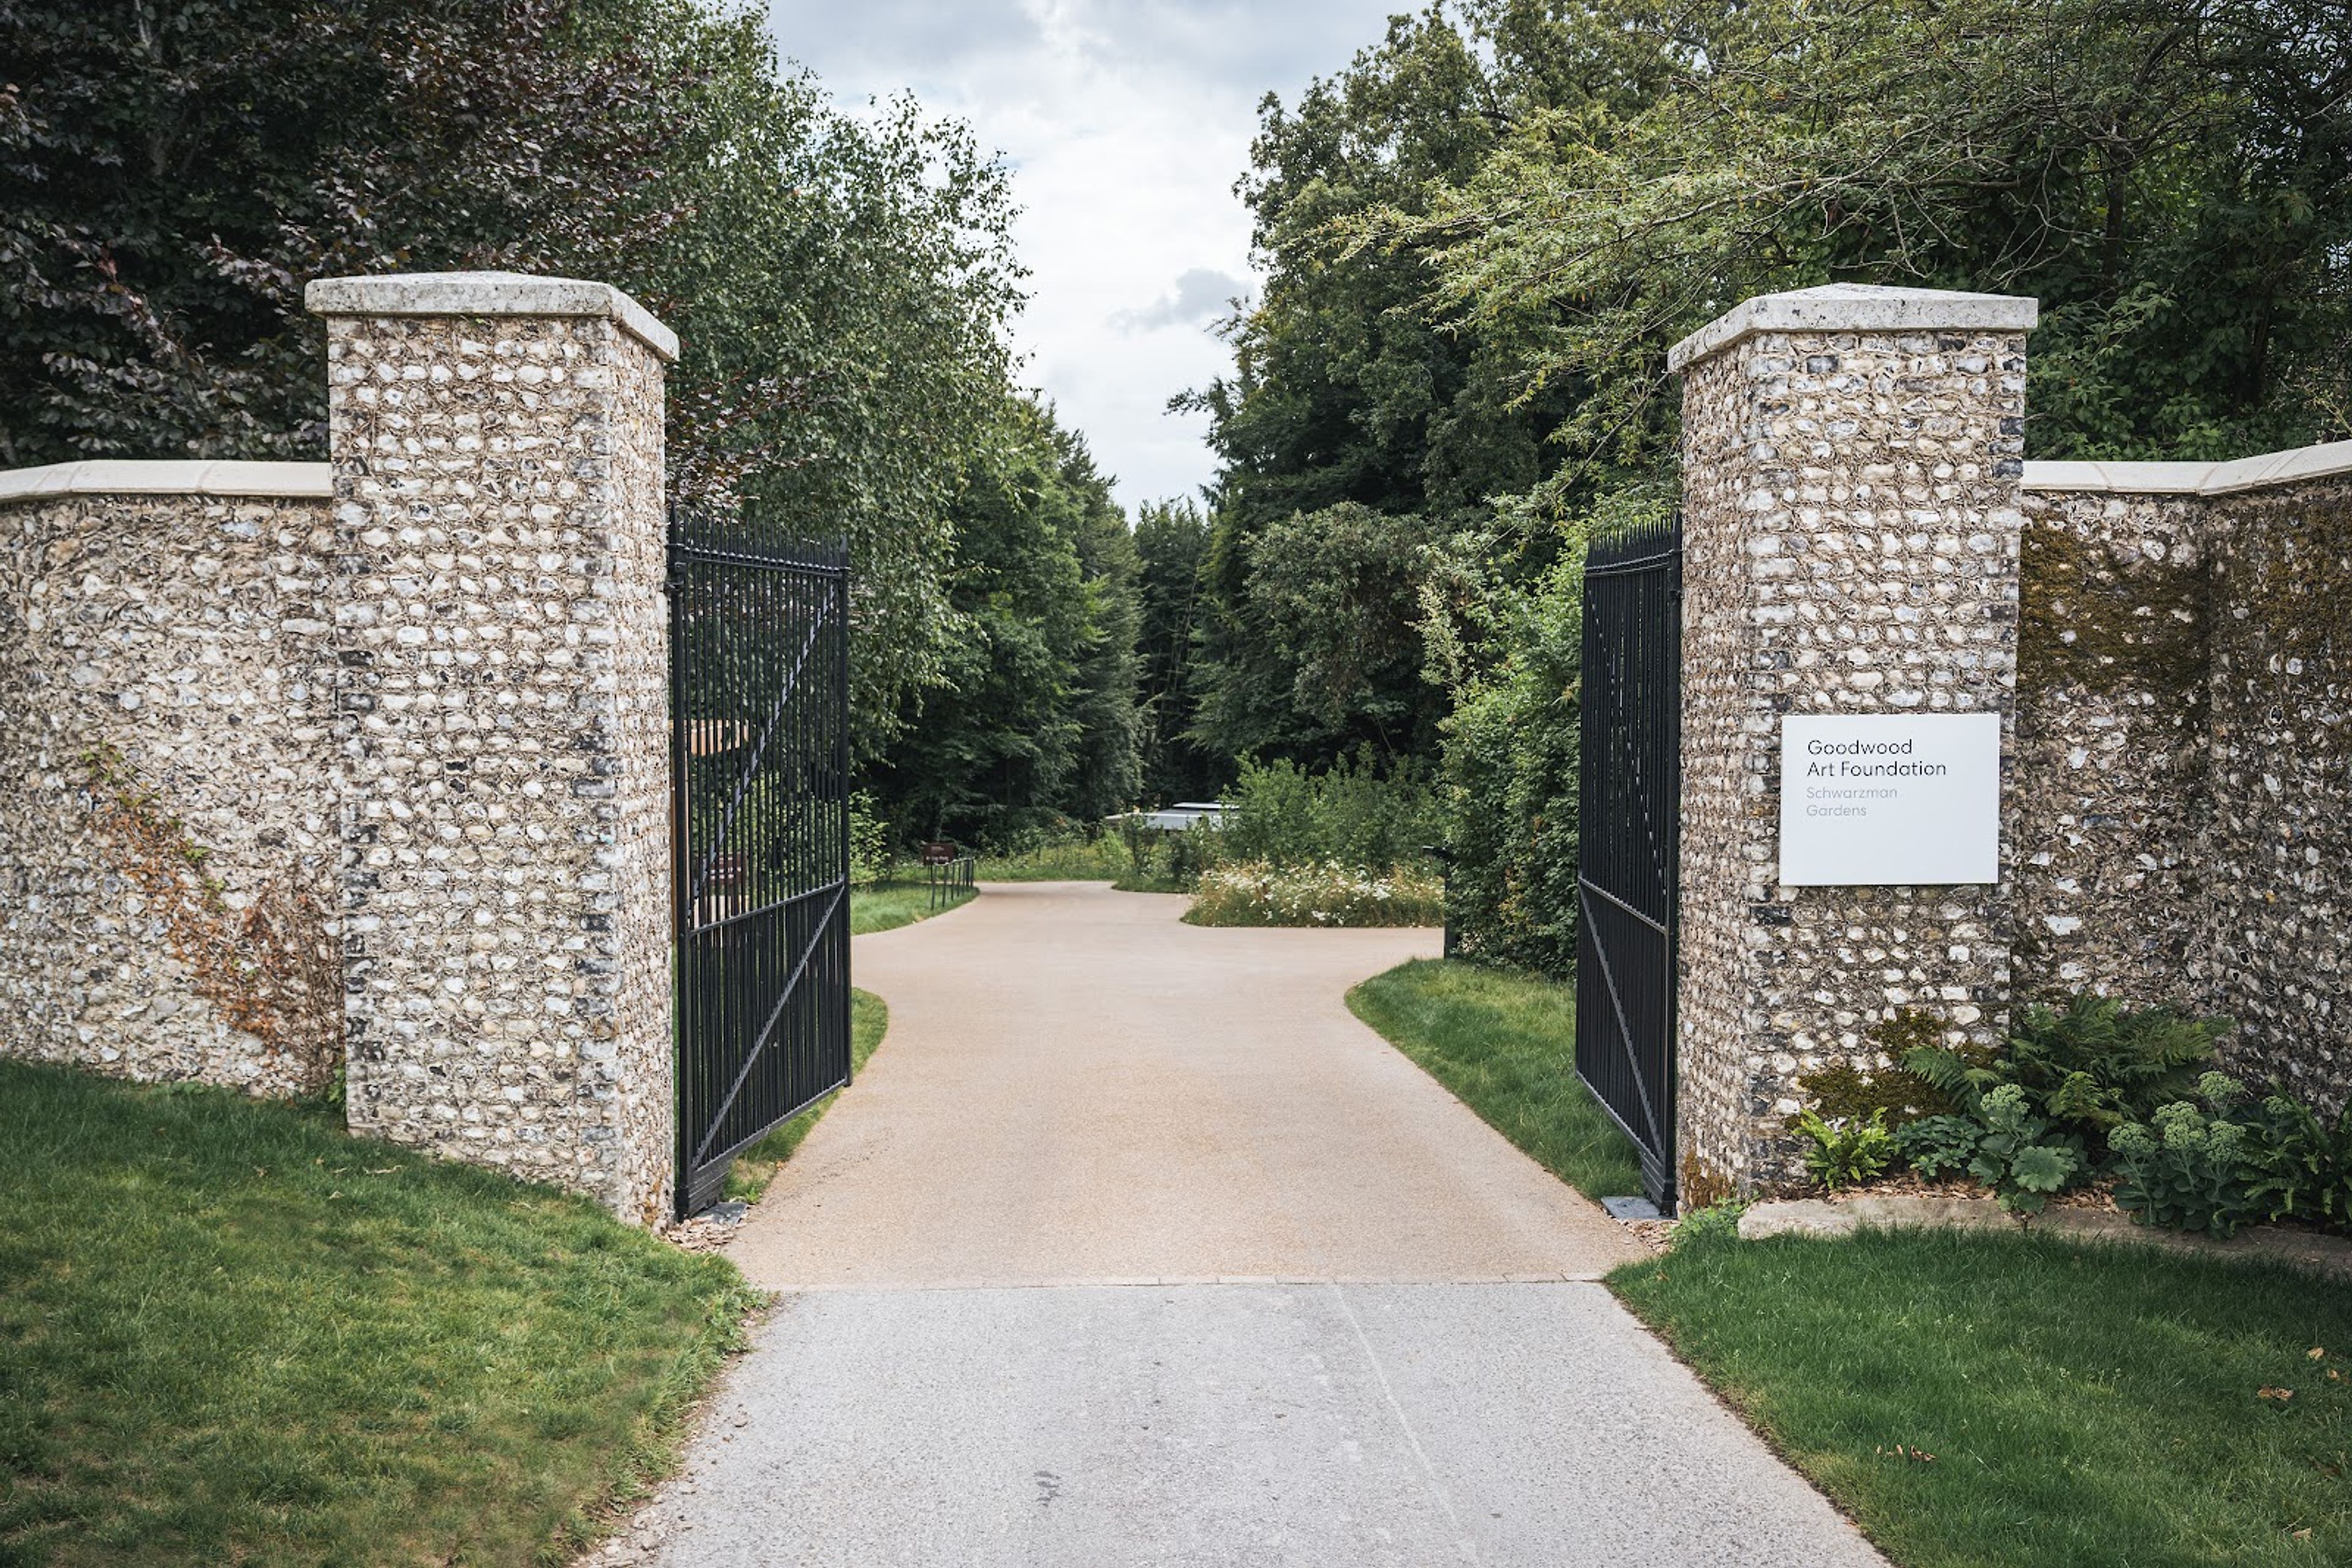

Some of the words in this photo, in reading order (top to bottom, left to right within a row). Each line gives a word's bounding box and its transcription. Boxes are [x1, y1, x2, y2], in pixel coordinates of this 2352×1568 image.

[1807, 739, 1912, 756] Goodwood
[1806, 761, 1835, 777] Art
[1841, 760, 1947, 777] Foundation
[1806, 786, 1898, 799] Schwarzman
[1806, 804, 1867, 816] Gardens
